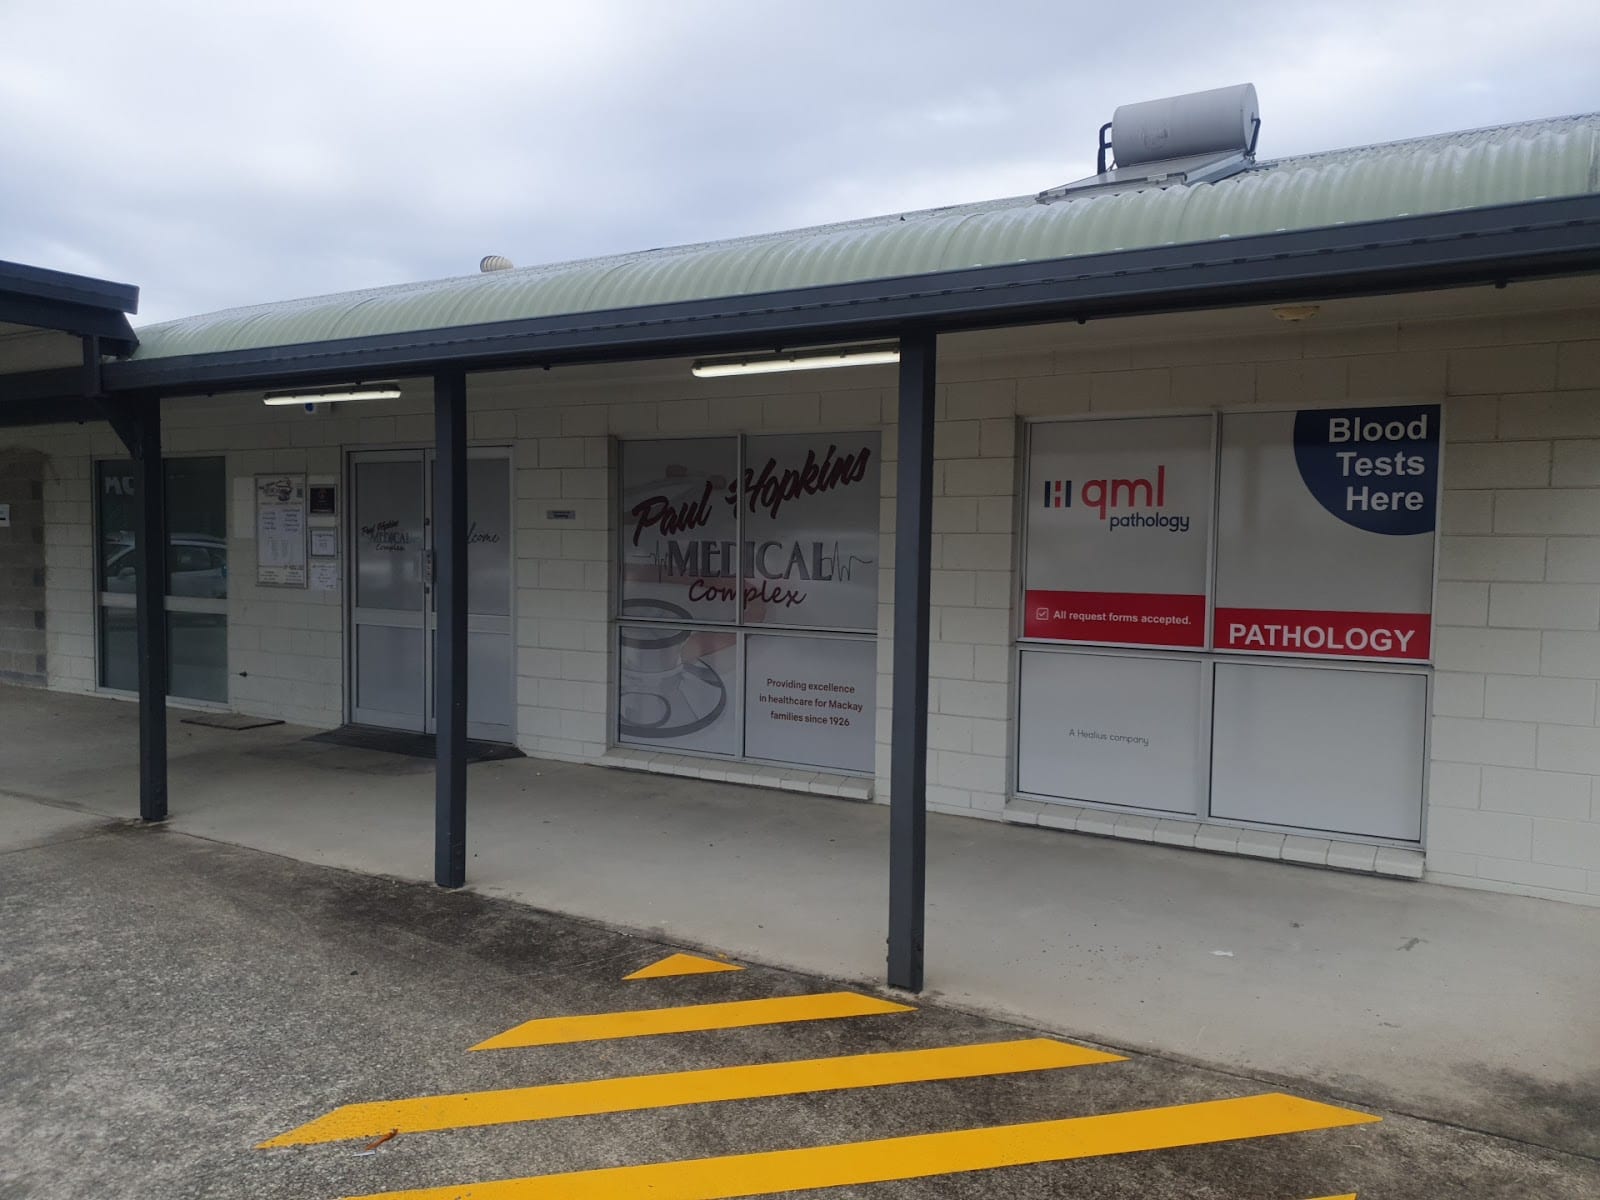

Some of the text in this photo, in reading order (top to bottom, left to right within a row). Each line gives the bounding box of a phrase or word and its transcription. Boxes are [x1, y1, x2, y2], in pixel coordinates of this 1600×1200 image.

[1329, 414, 1428, 443] Blood
[1336, 451, 1425, 477] Tests
[632, 445, 871, 546] Paul Hopkins
[1081, 465, 1165, 520] qml
[1346, 486, 1424, 511] Here
[1109, 512, 1190, 532] pathology
[667, 541, 832, 581] MEDICAL
[689, 579, 807, 609] Complex
[1053, 610, 1192, 626] All request forms accepted.
[1229, 623, 1415, 653] PATHOLOGY
[766, 678, 855, 694] Providing excellence
[759, 693, 863, 712] in healthcare for Mackay
[770, 710, 850, 727] families since 1926
[1069, 728, 1149, 747] A Healius company
